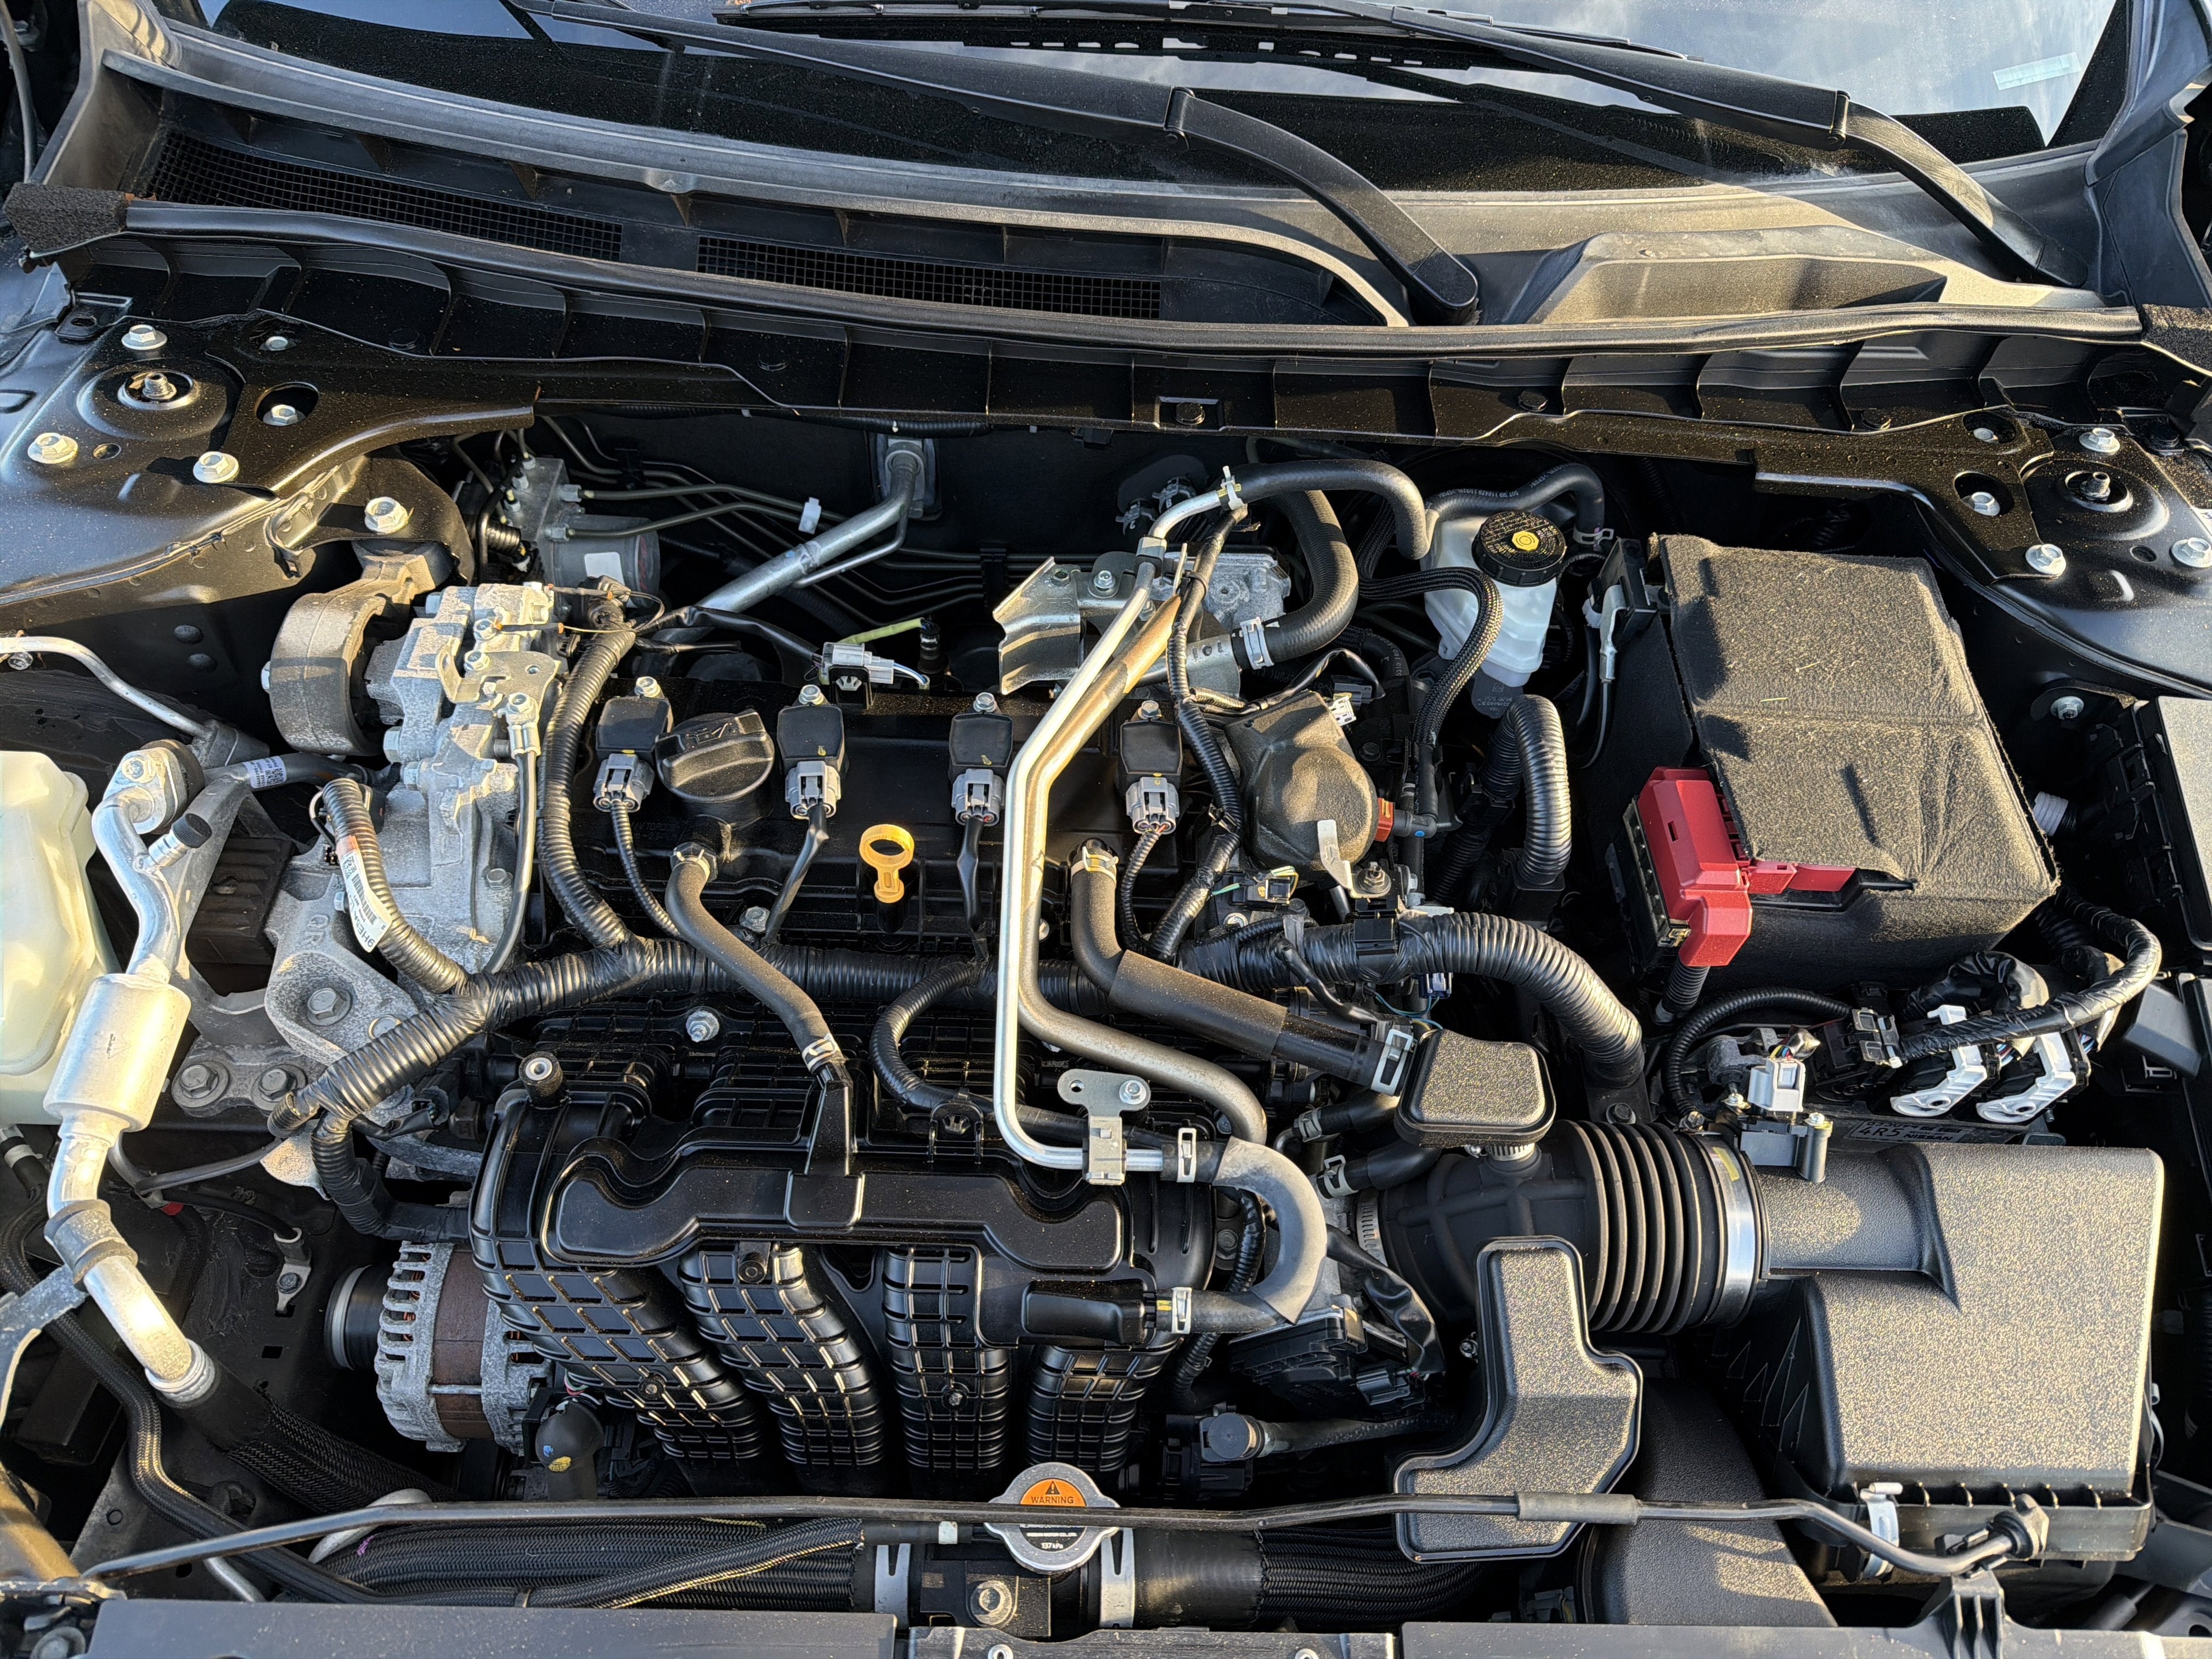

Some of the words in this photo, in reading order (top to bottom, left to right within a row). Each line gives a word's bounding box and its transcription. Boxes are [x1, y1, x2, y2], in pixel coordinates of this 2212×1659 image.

[1859, 1126, 1905, 1137] 4R5
[1904, 1133, 1954, 1141] NISSAN
[1031, 1496, 1074, 1504] WARNING
